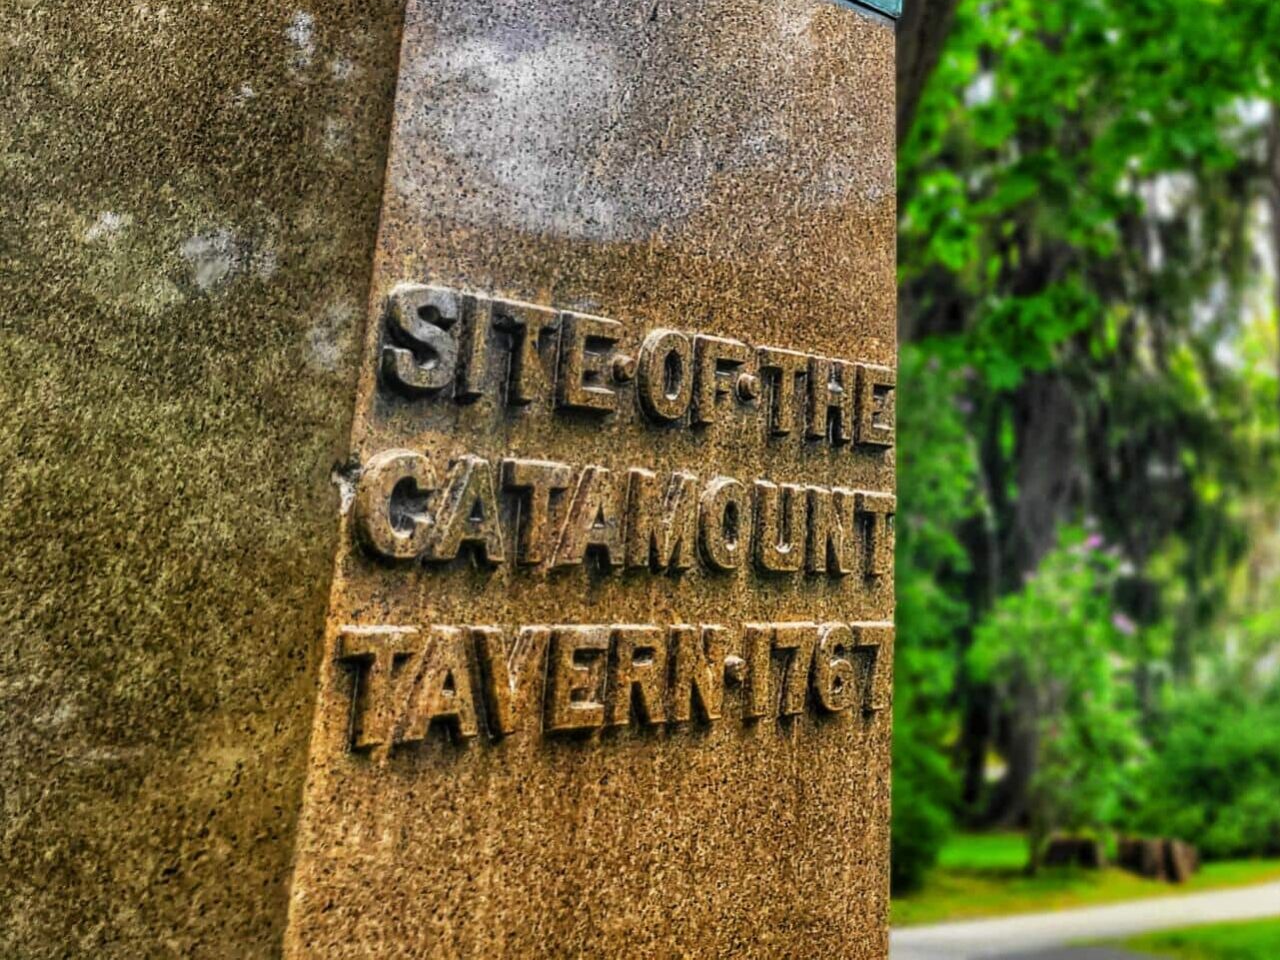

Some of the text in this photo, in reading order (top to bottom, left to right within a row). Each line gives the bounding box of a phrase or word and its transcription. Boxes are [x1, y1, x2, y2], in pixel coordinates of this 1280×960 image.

[383, 283, 895, 447] SITE OF THE
[354, 449, 895, 577] CATAMOUNT
[338, 621, 895, 749] TAVERN 1767
